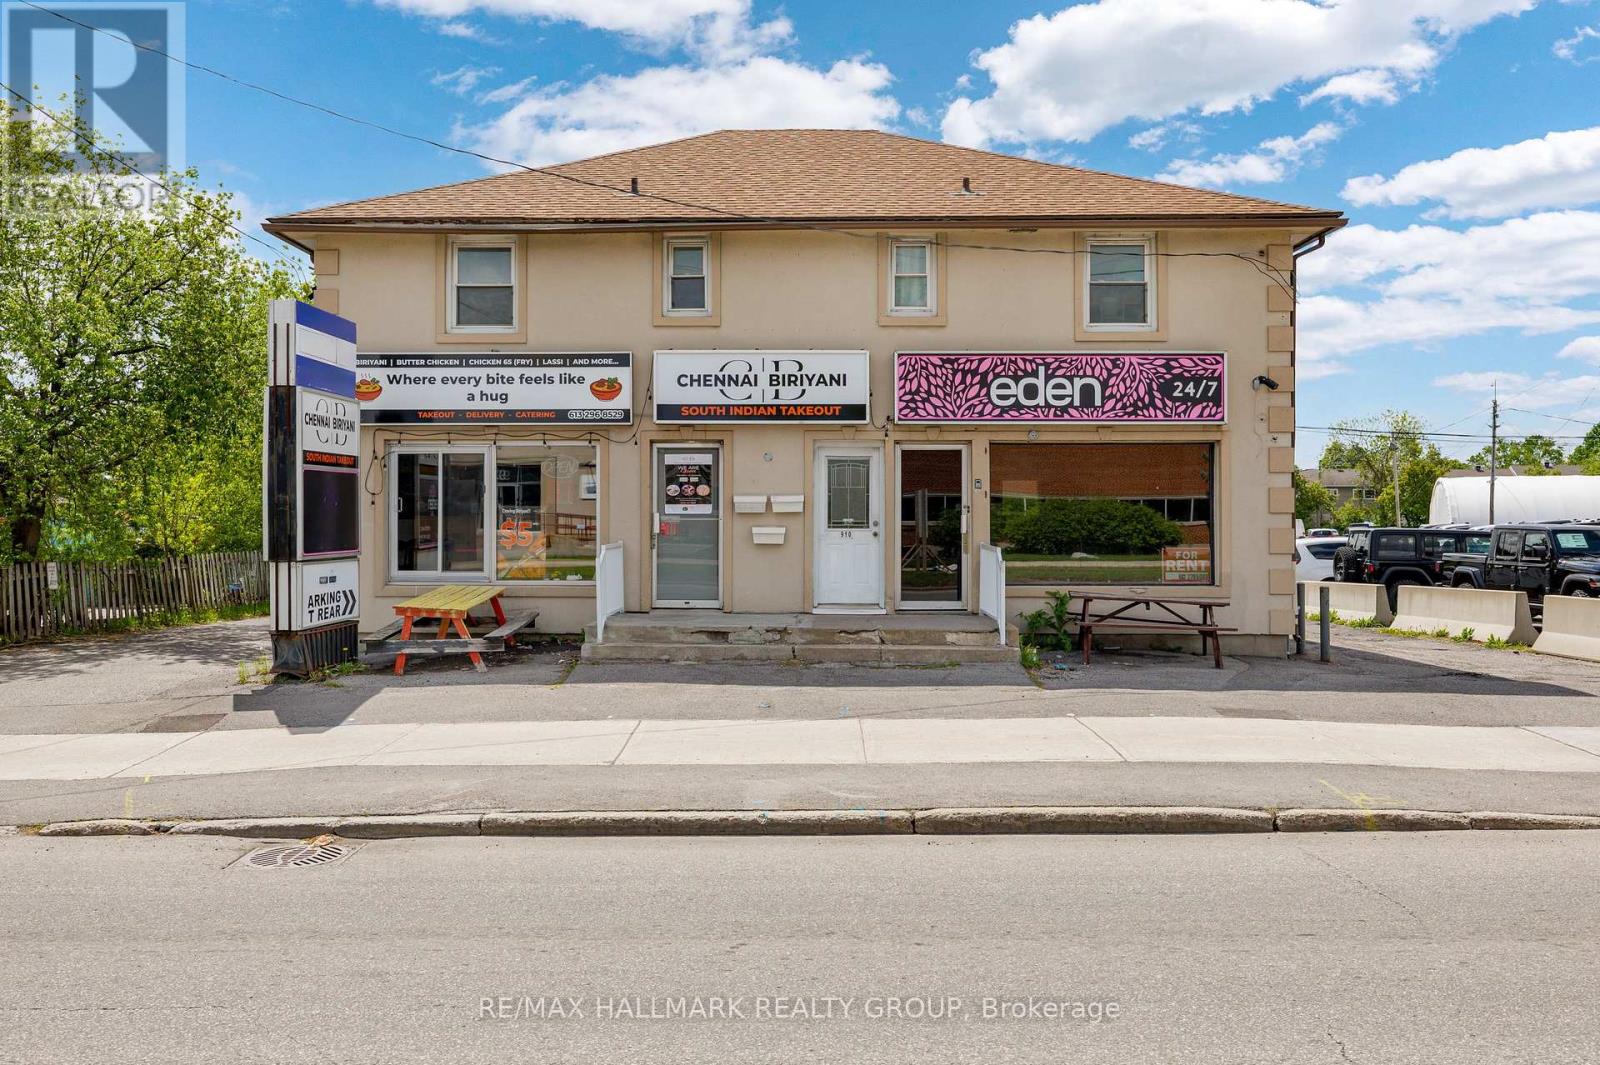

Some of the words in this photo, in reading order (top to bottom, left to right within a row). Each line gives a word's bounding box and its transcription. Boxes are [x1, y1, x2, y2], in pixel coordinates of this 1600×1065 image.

[513, 358, 533, 367] (FRY)
[386, 373, 437, 386] Where
[440, 376, 483, 387] every
[486, 372, 515, 385] bite
[518, 372, 555, 385] feels
[558, 371, 586, 385] like
[676, 373, 758, 388] CHENNAI
[768, 373, 847, 387] BIRIYANI
[989, 365, 1102, 407] eden
[1172, 380, 1218, 398] 24/7
[466, 393, 475, 402] a
[479, 391, 509, 404] hug
[417, 411, 455, 419] TAKEOUT
[466, 411, 505, 419] DELIVERY
[515, 411, 556, 419] CATERING
[680, 406, 726, 417] SOUTH
[729, 406, 777, 417] INDIAN
[780, 406, 842, 417] TAKEOUT
[304, 412, 331, 428] CHENNAI
[332, 417, 356, 433] BIRIYANI
[306, 452, 322, 462] SOUTH
[499, 517, 533, 550] $5
[1175, 551, 1198, 560] FOR
[1167, 560, 1208, 572] RENT
[308, 590, 342, 609] ARKING
[308, 610, 315, 623] T
[317, 604, 341, 622] REAR
